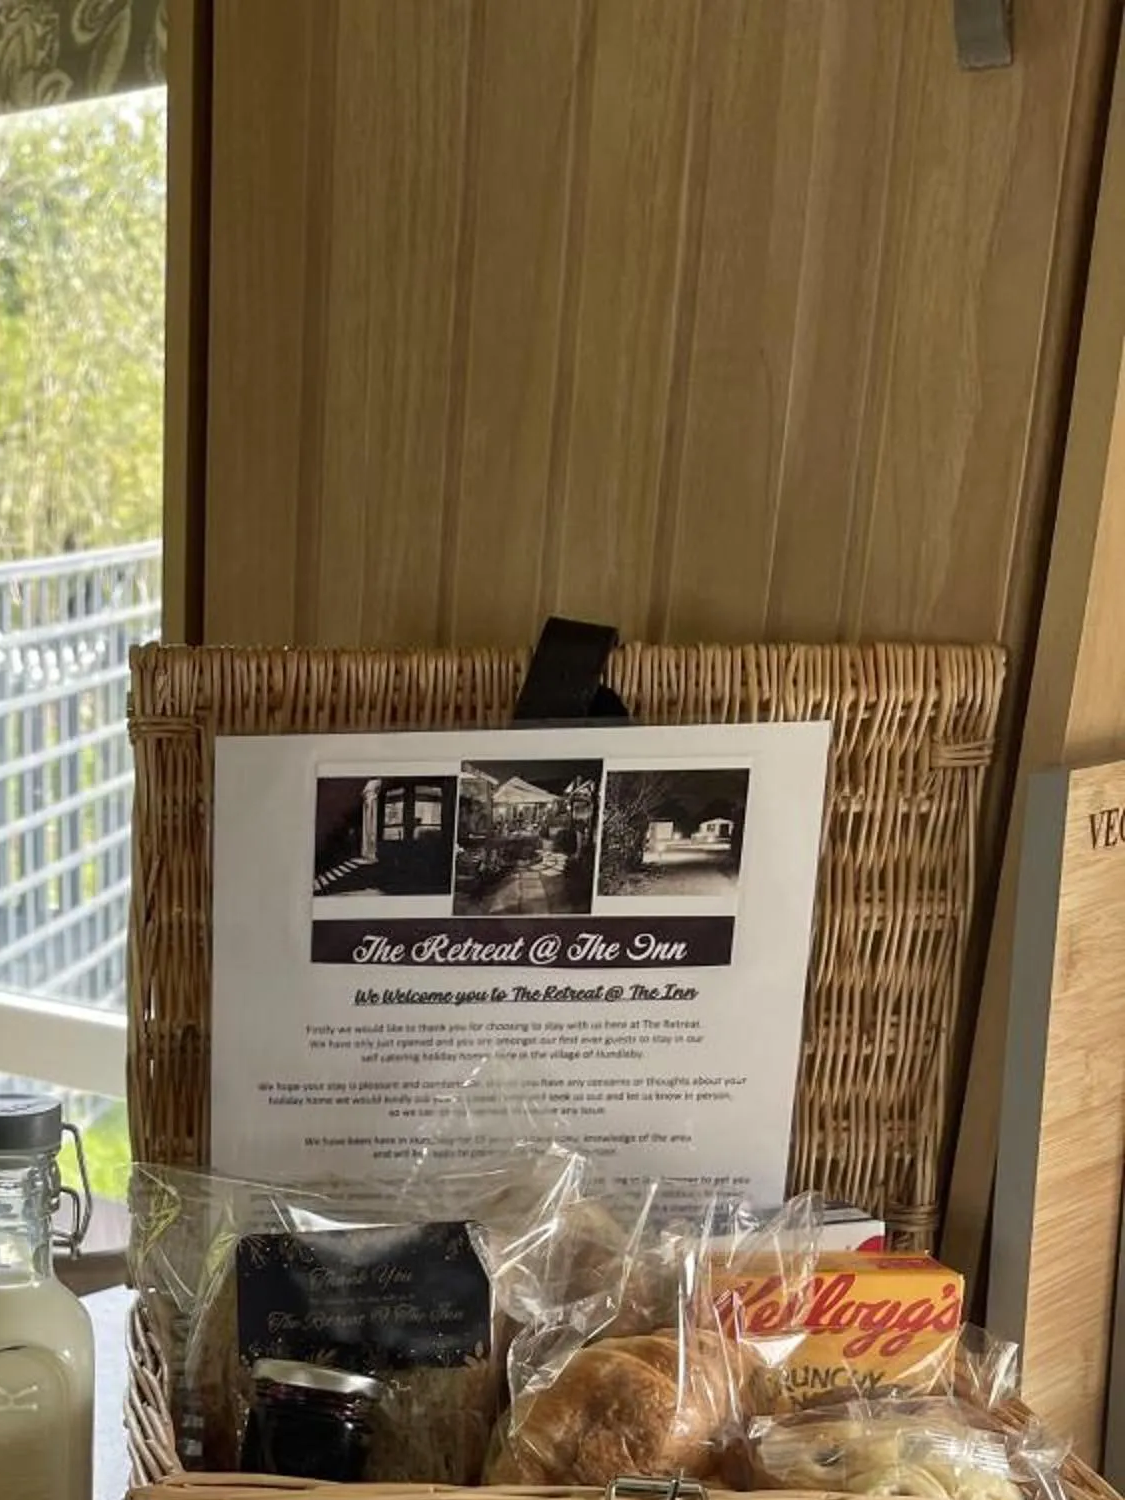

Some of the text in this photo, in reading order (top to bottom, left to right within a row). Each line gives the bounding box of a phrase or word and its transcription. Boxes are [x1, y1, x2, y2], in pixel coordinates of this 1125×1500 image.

[352, 932, 688, 965] The Retreat @ The Inn
[354, 983, 700, 1007] We Welcome you to The Retreat @ The Inn
[354, 1024, 384, 1034] would
[386, 1023, 403, 1033] like
[405, 1024, 416, 1033] to
[418, 1023, 446, 1033] thank
[448, 1024, 467, 1035] you
[468, 1022, 483, 1032] for
[485, 1021, 529, 1032] choosing
[532, 1022, 543, 1031] to
[544, 1021, 565, 1032] stay
[566, 1020, 589, 1030] with
[604, 1020, 627, 1030] here
[630, 1020, 640, 1030] at
[642, 1019, 660, 1029] The
[328, 1039, 351, 1049] have
[435, 1037, 454, 1048] and
[456, 1039, 475, 1049] you
[559, 1035, 578, 1046] first
[580, 1036, 603, 1045] ever
[604, 1035, 637, 1047] guests
[639, 1035, 650, 1045] to
[652, 1035, 672, 1046] stay
[530, 1050, 547, 1060] the
[550, 1050, 581, 1061] village
[582, 1049, 594, 1060] of
[327, 1081, 346, 1093] stay
[402, 1079, 420, 1090] and
[541, 1076, 565, 1087] have
[566, 1077, 585, 1089] any
[633, 1078, 644, 1087] or
[646, 1075, 690, 1088] thoughts
[692, 1075, 722, 1086] about
[352, 1095, 381, 1105] would
[606, 1090, 624, 1101] and
[626, 1090, 639, 1101] let
[655, 1090, 682, 1101] know
[684, 1090, 694, 1100] in
[321, 1136, 345, 1147] have
[347, 1135, 371, 1146] been
[373, 1135, 397, 1146] here
[399, 1135, 408, 1146] in
[583, 1133, 637, 1145] knowledge
[639, 1133, 651, 1144] of
[652, 1133, 668, 1144] the
[373, 1148, 393, 1159] and
[714, 1273, 961, 1358] Kellogg's
